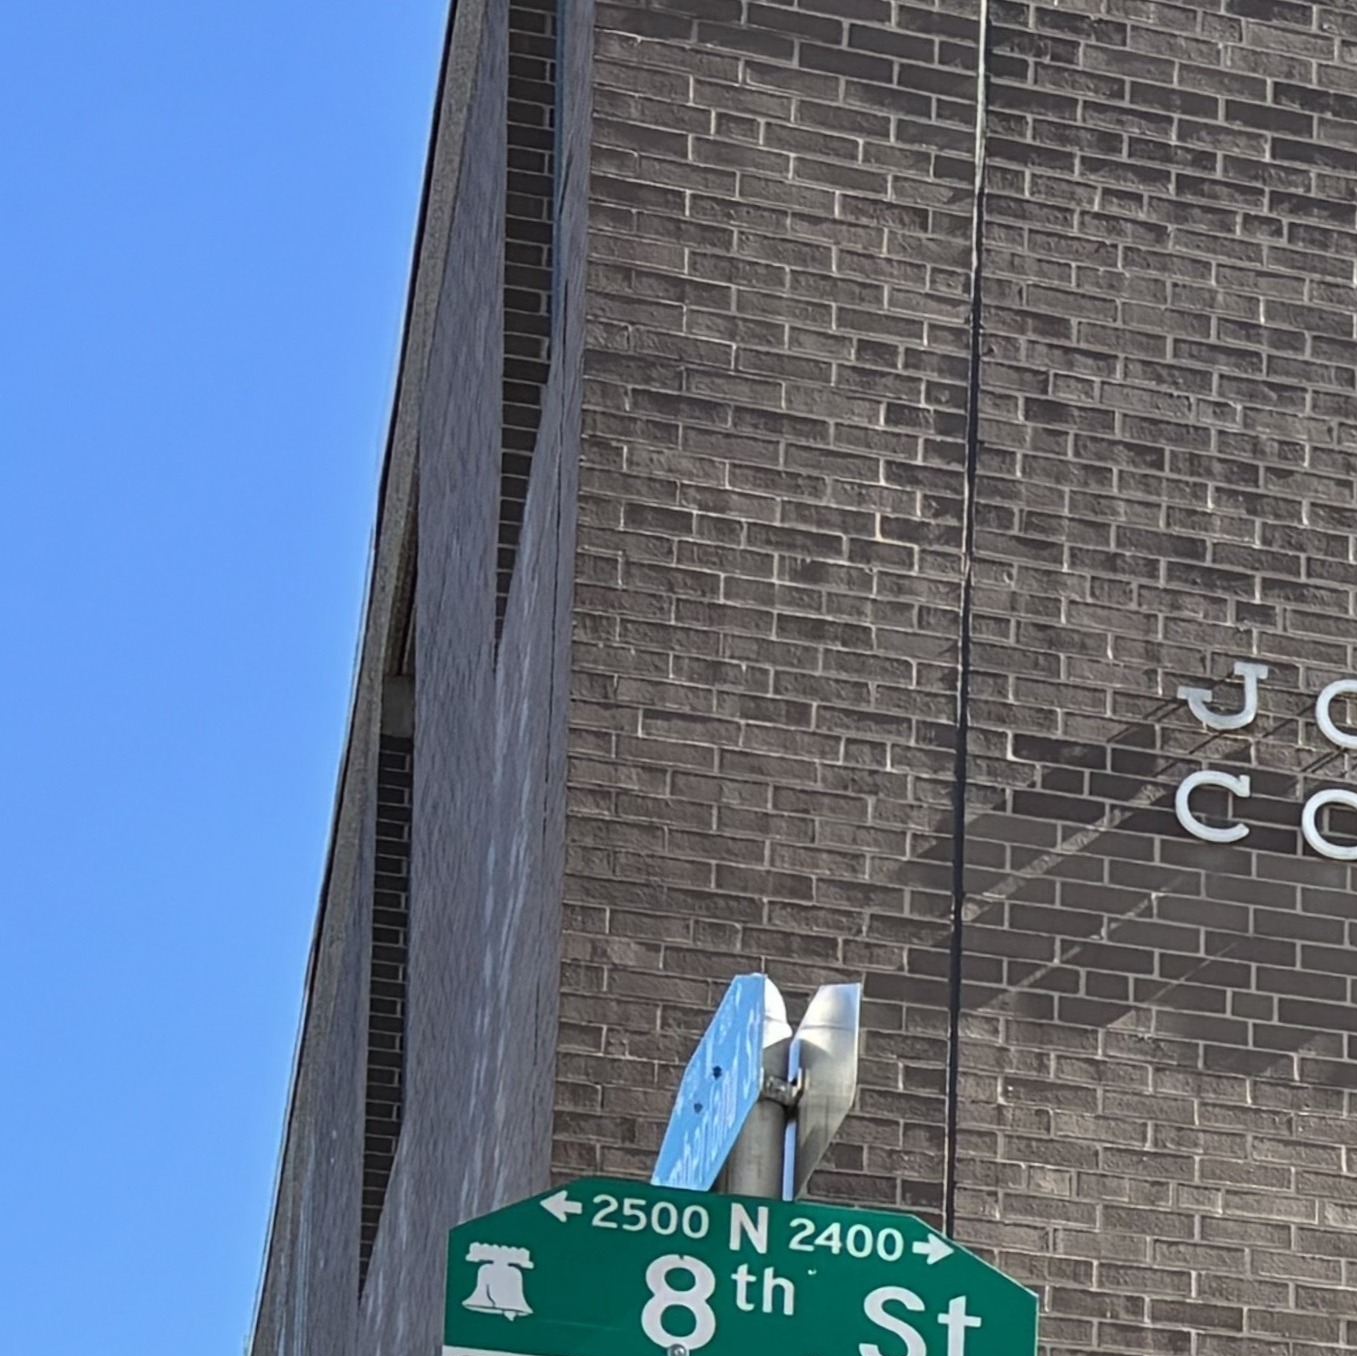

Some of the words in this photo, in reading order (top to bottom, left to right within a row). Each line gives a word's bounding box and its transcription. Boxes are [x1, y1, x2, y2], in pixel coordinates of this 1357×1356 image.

[591, 1194, 710, 1240] 2500
[729, 1205, 769, 1255] N
[788, 1217, 903, 1263] 2400
[640, 1254, 796, 1351] 8th
